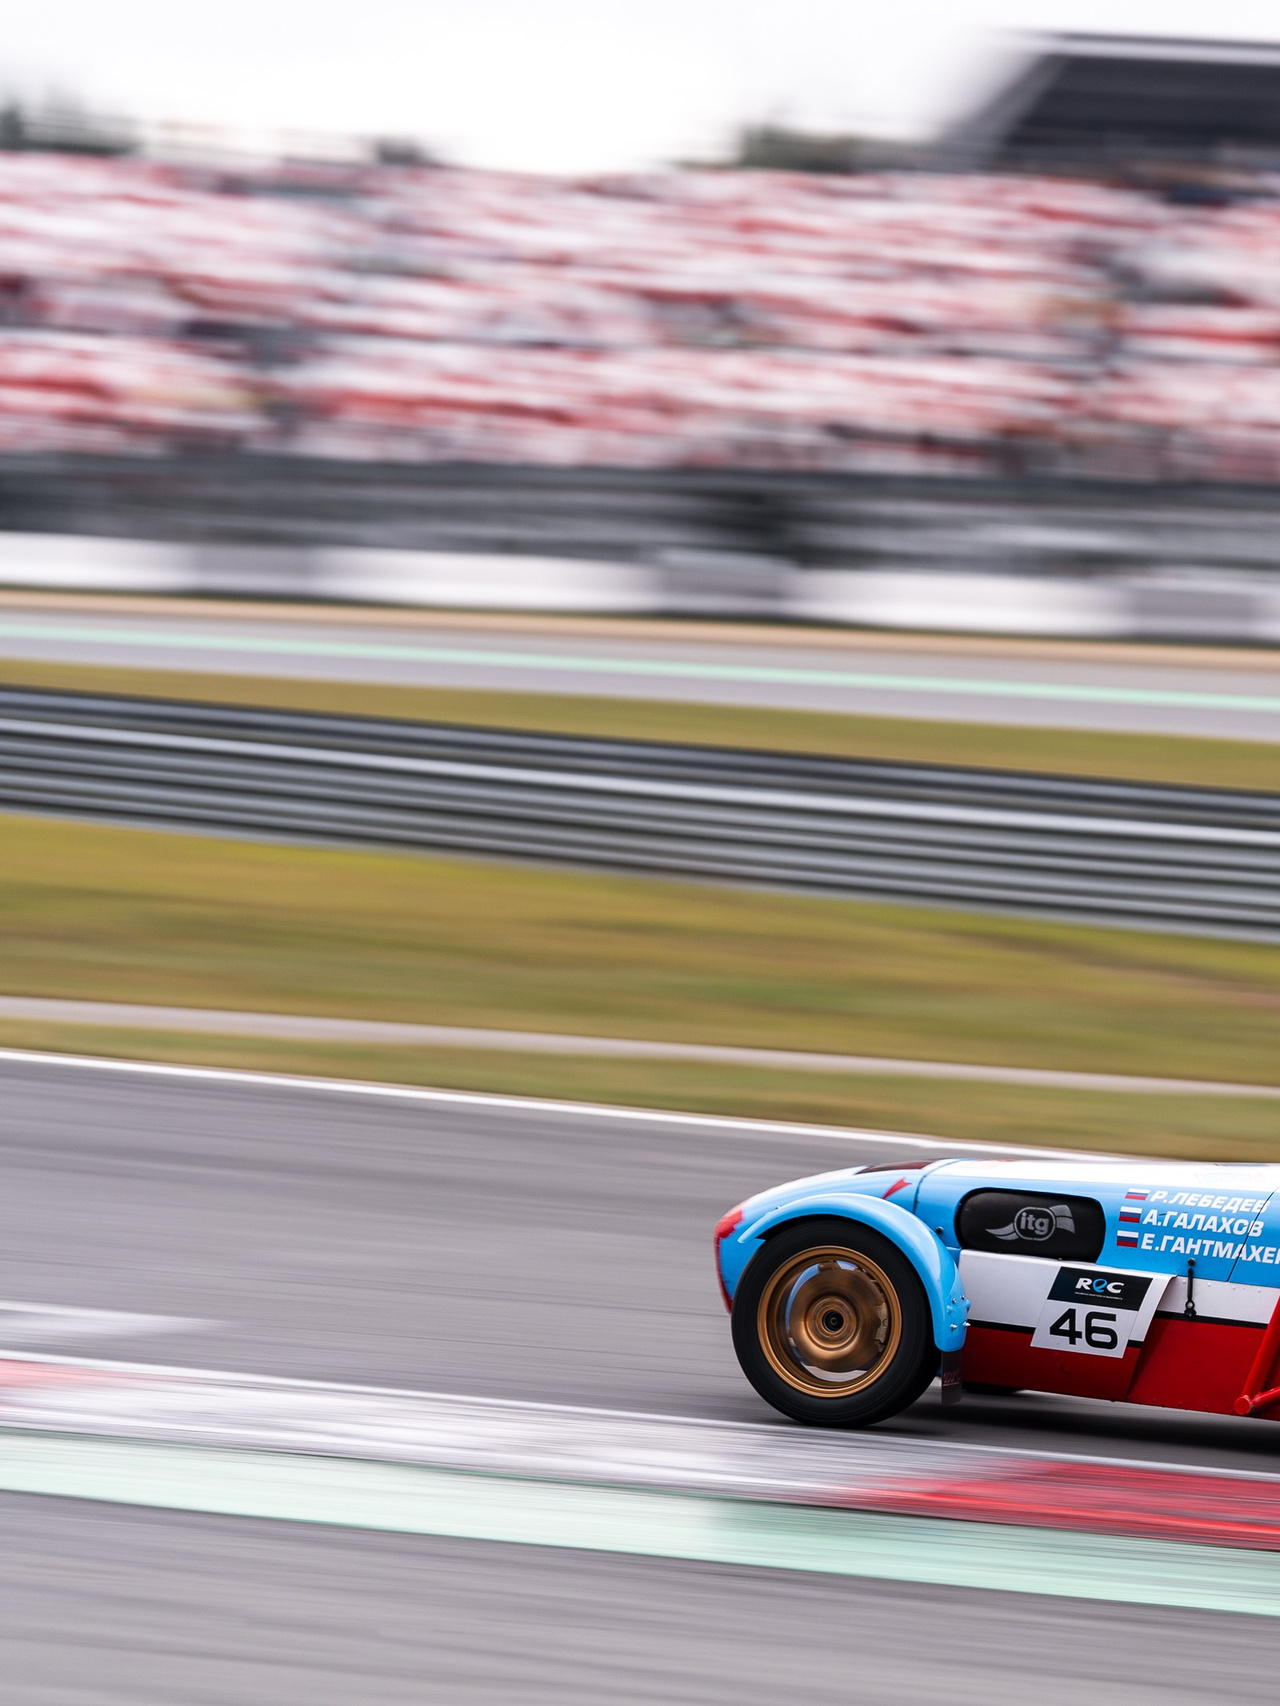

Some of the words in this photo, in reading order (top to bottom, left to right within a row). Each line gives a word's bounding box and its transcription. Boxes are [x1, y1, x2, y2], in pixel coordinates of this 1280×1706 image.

[1149, 1190, 1271, 1214] Р.ЛЕБЕДЕВ
[1020, 1211, 1050, 1235] itg
[1142, 1209, 1265, 1237] А.ГАЛАХОВ
[1049, 1308, 1119, 1350] 46
